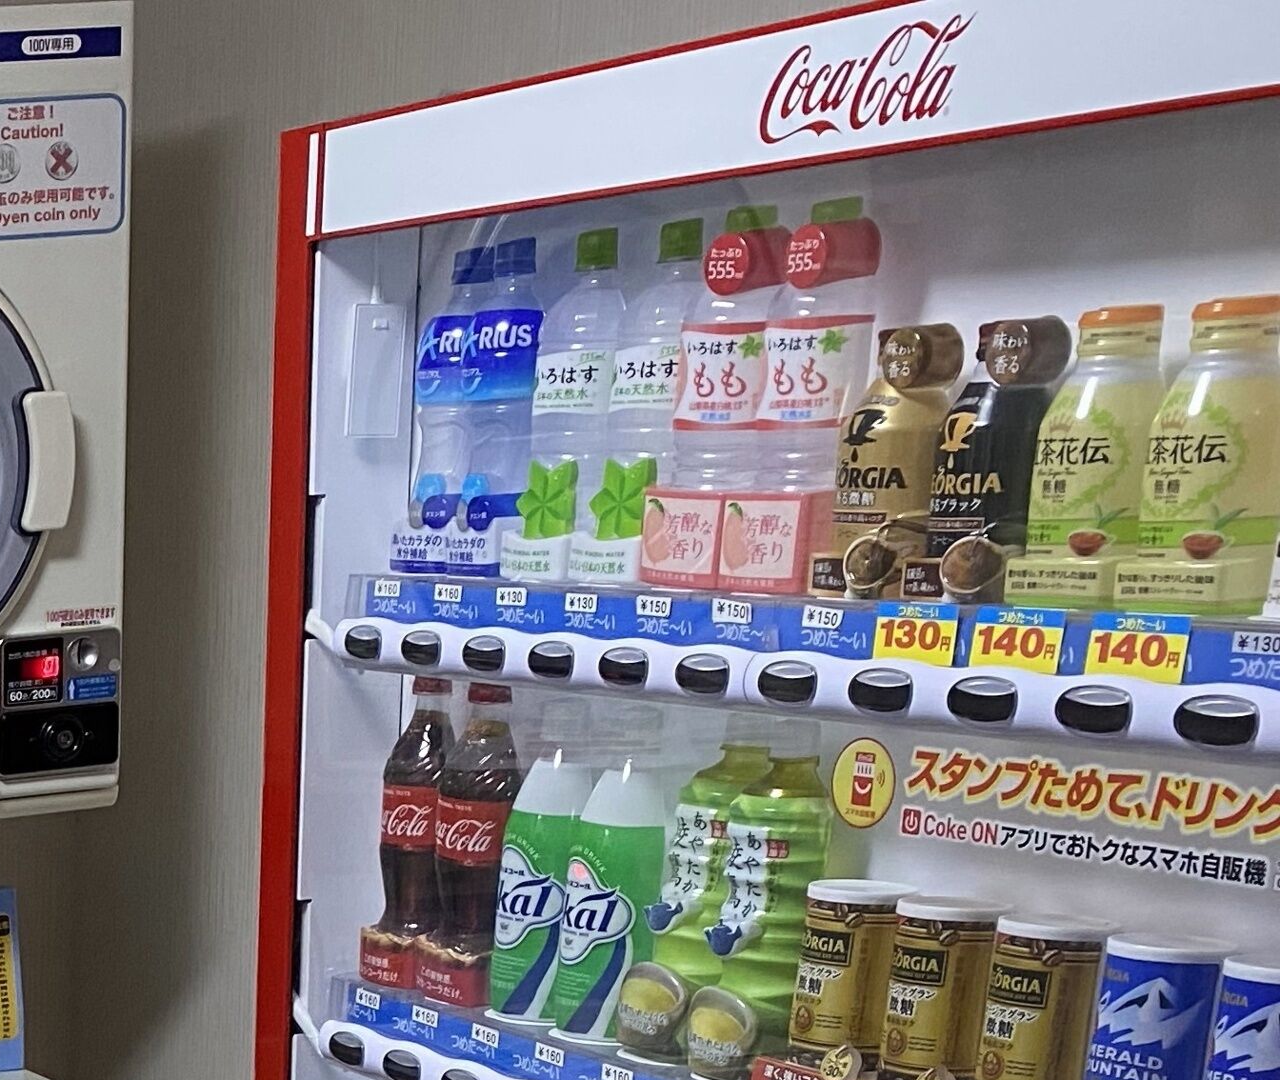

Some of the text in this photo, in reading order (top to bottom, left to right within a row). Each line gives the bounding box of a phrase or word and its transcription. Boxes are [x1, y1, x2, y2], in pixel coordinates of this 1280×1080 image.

[760, 11, 978, 144] Coca-Cola
[0, 124, 64, 141] Caution!
[34, 209, 65, 224] coin
[69, 206, 100, 224] only
[711, 248, 743, 258] たっぷり
[791, 240, 819, 251] たっぷり
[774, 357, 828, 395] もも
[993, 355, 1020, 375] 香る
[694, 361, 747, 397] もも
[1035, 437, 1110, 465] 茶花伝
[1144, 434, 1228, 464] 茶花伝
[672, 539, 704, 560] 香り
[750, 539, 784, 563] 香り
[376, 582, 399, 596] ¥160
[568, 596, 595, 610] ¥130
[807, 611, 839, 626] ¥150
[880, 618, 951, 652] 130円
[978, 627, 1056, 659] 140円
[1094, 634, 1181, 668] 140円
[923, 815, 967, 840] Coke
[414, 1008, 437, 1025] ¥160
